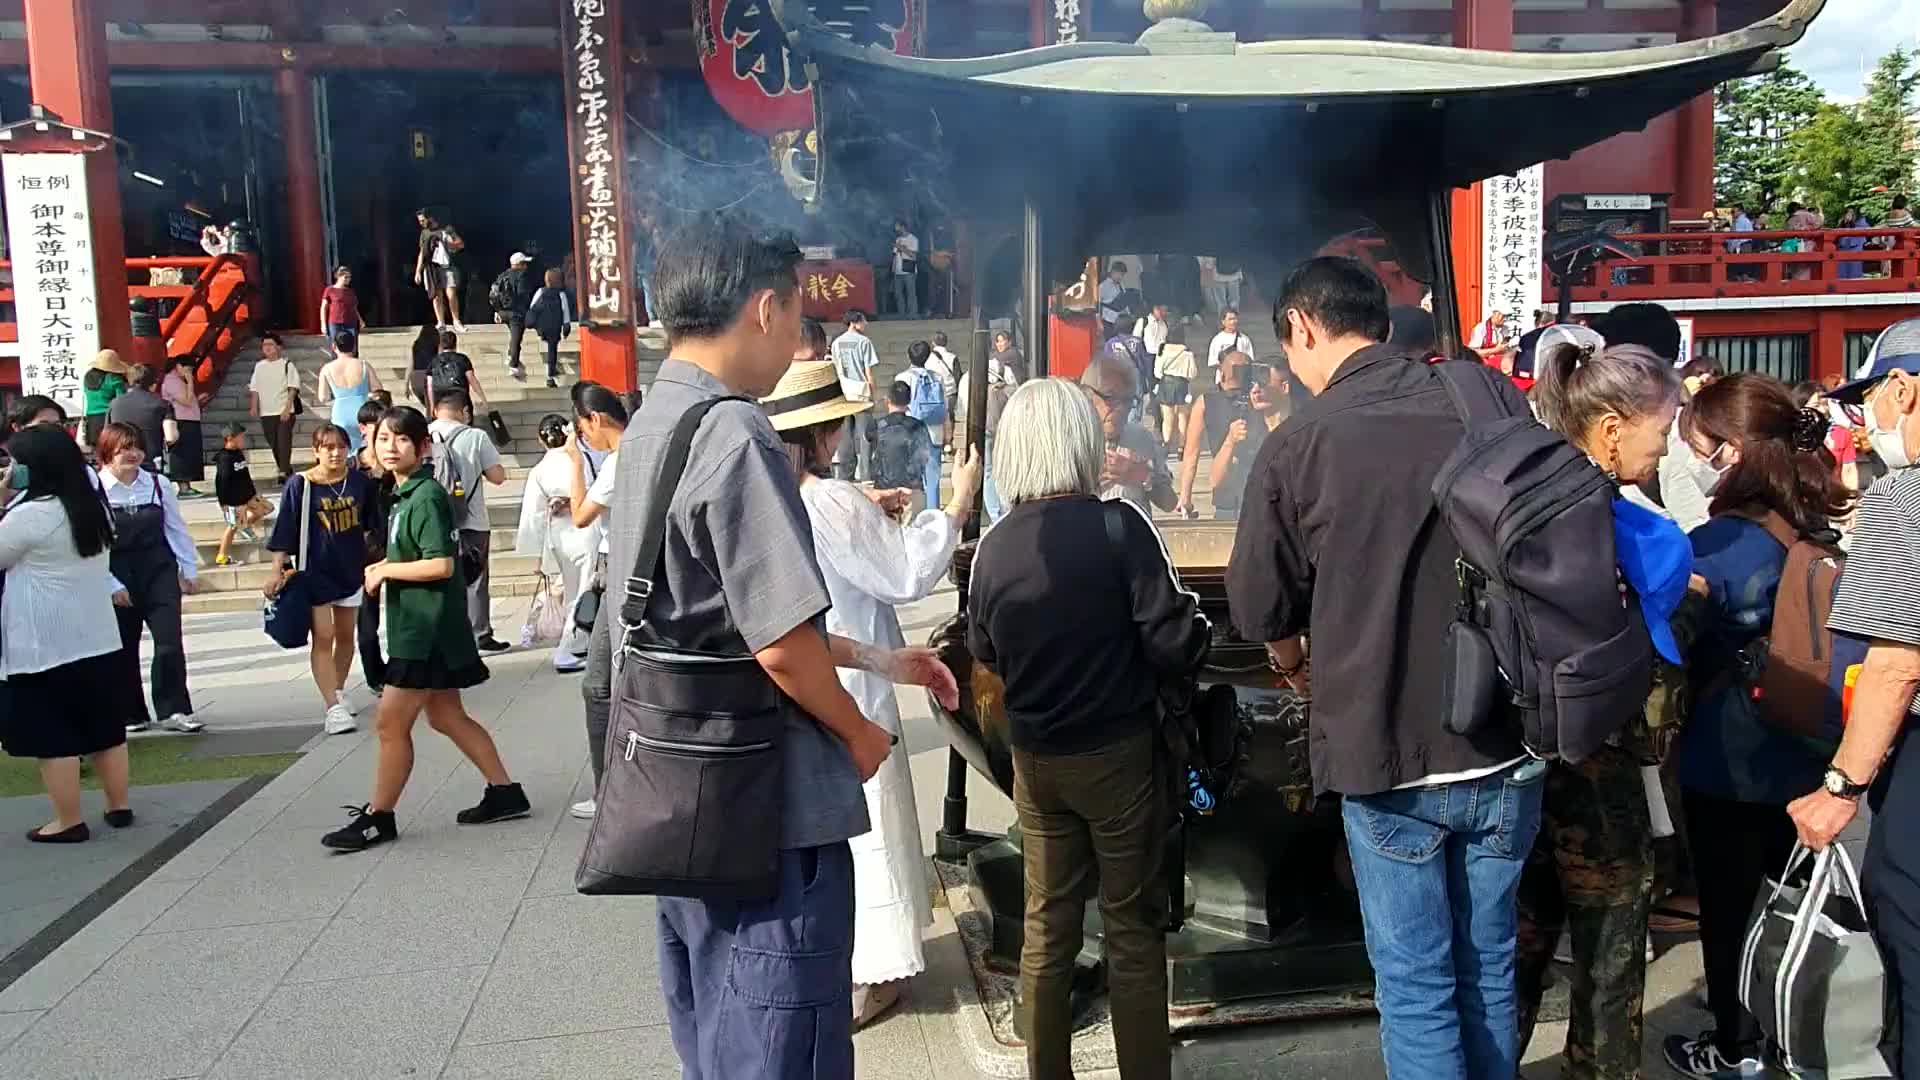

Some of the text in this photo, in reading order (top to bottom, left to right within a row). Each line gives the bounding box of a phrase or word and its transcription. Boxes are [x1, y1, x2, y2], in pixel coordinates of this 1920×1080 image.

[18, 175, 70, 190] 恒例
[1593, 199, 1620, 208] みくじ
